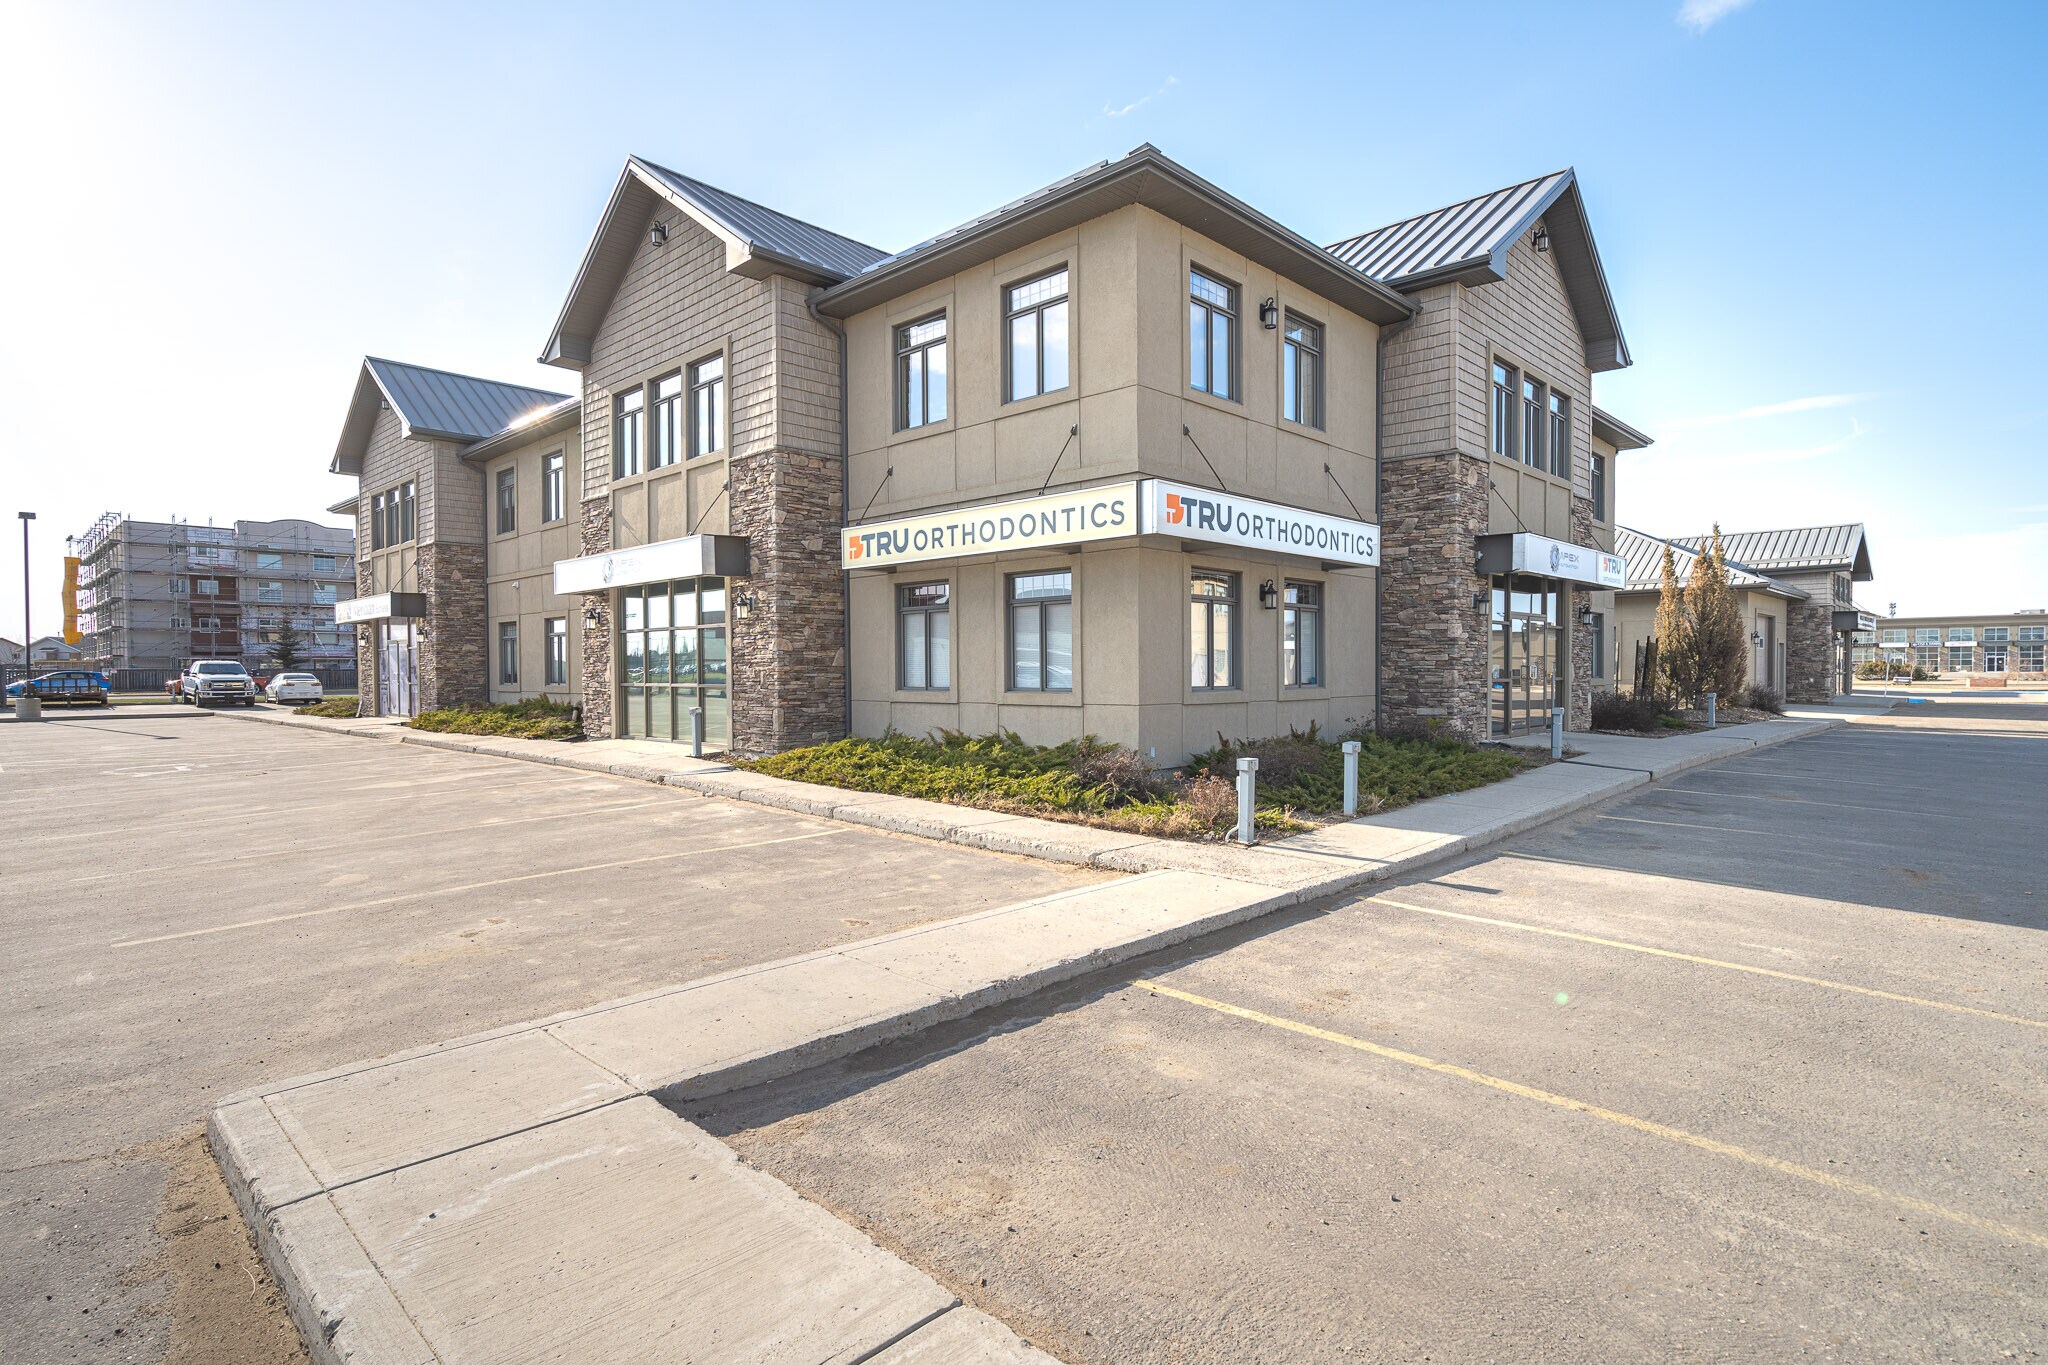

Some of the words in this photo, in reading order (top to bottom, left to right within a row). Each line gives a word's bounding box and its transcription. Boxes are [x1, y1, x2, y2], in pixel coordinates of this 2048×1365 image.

[861, 528, 908, 558] TRU
[913, 500, 1125, 551] ORTHODONTICS
[1181, 496, 1232, 532] TRU
[1236, 511, 1374, 557] ORTHODONTICS
[1607, 558, 1622, 574] TRU
